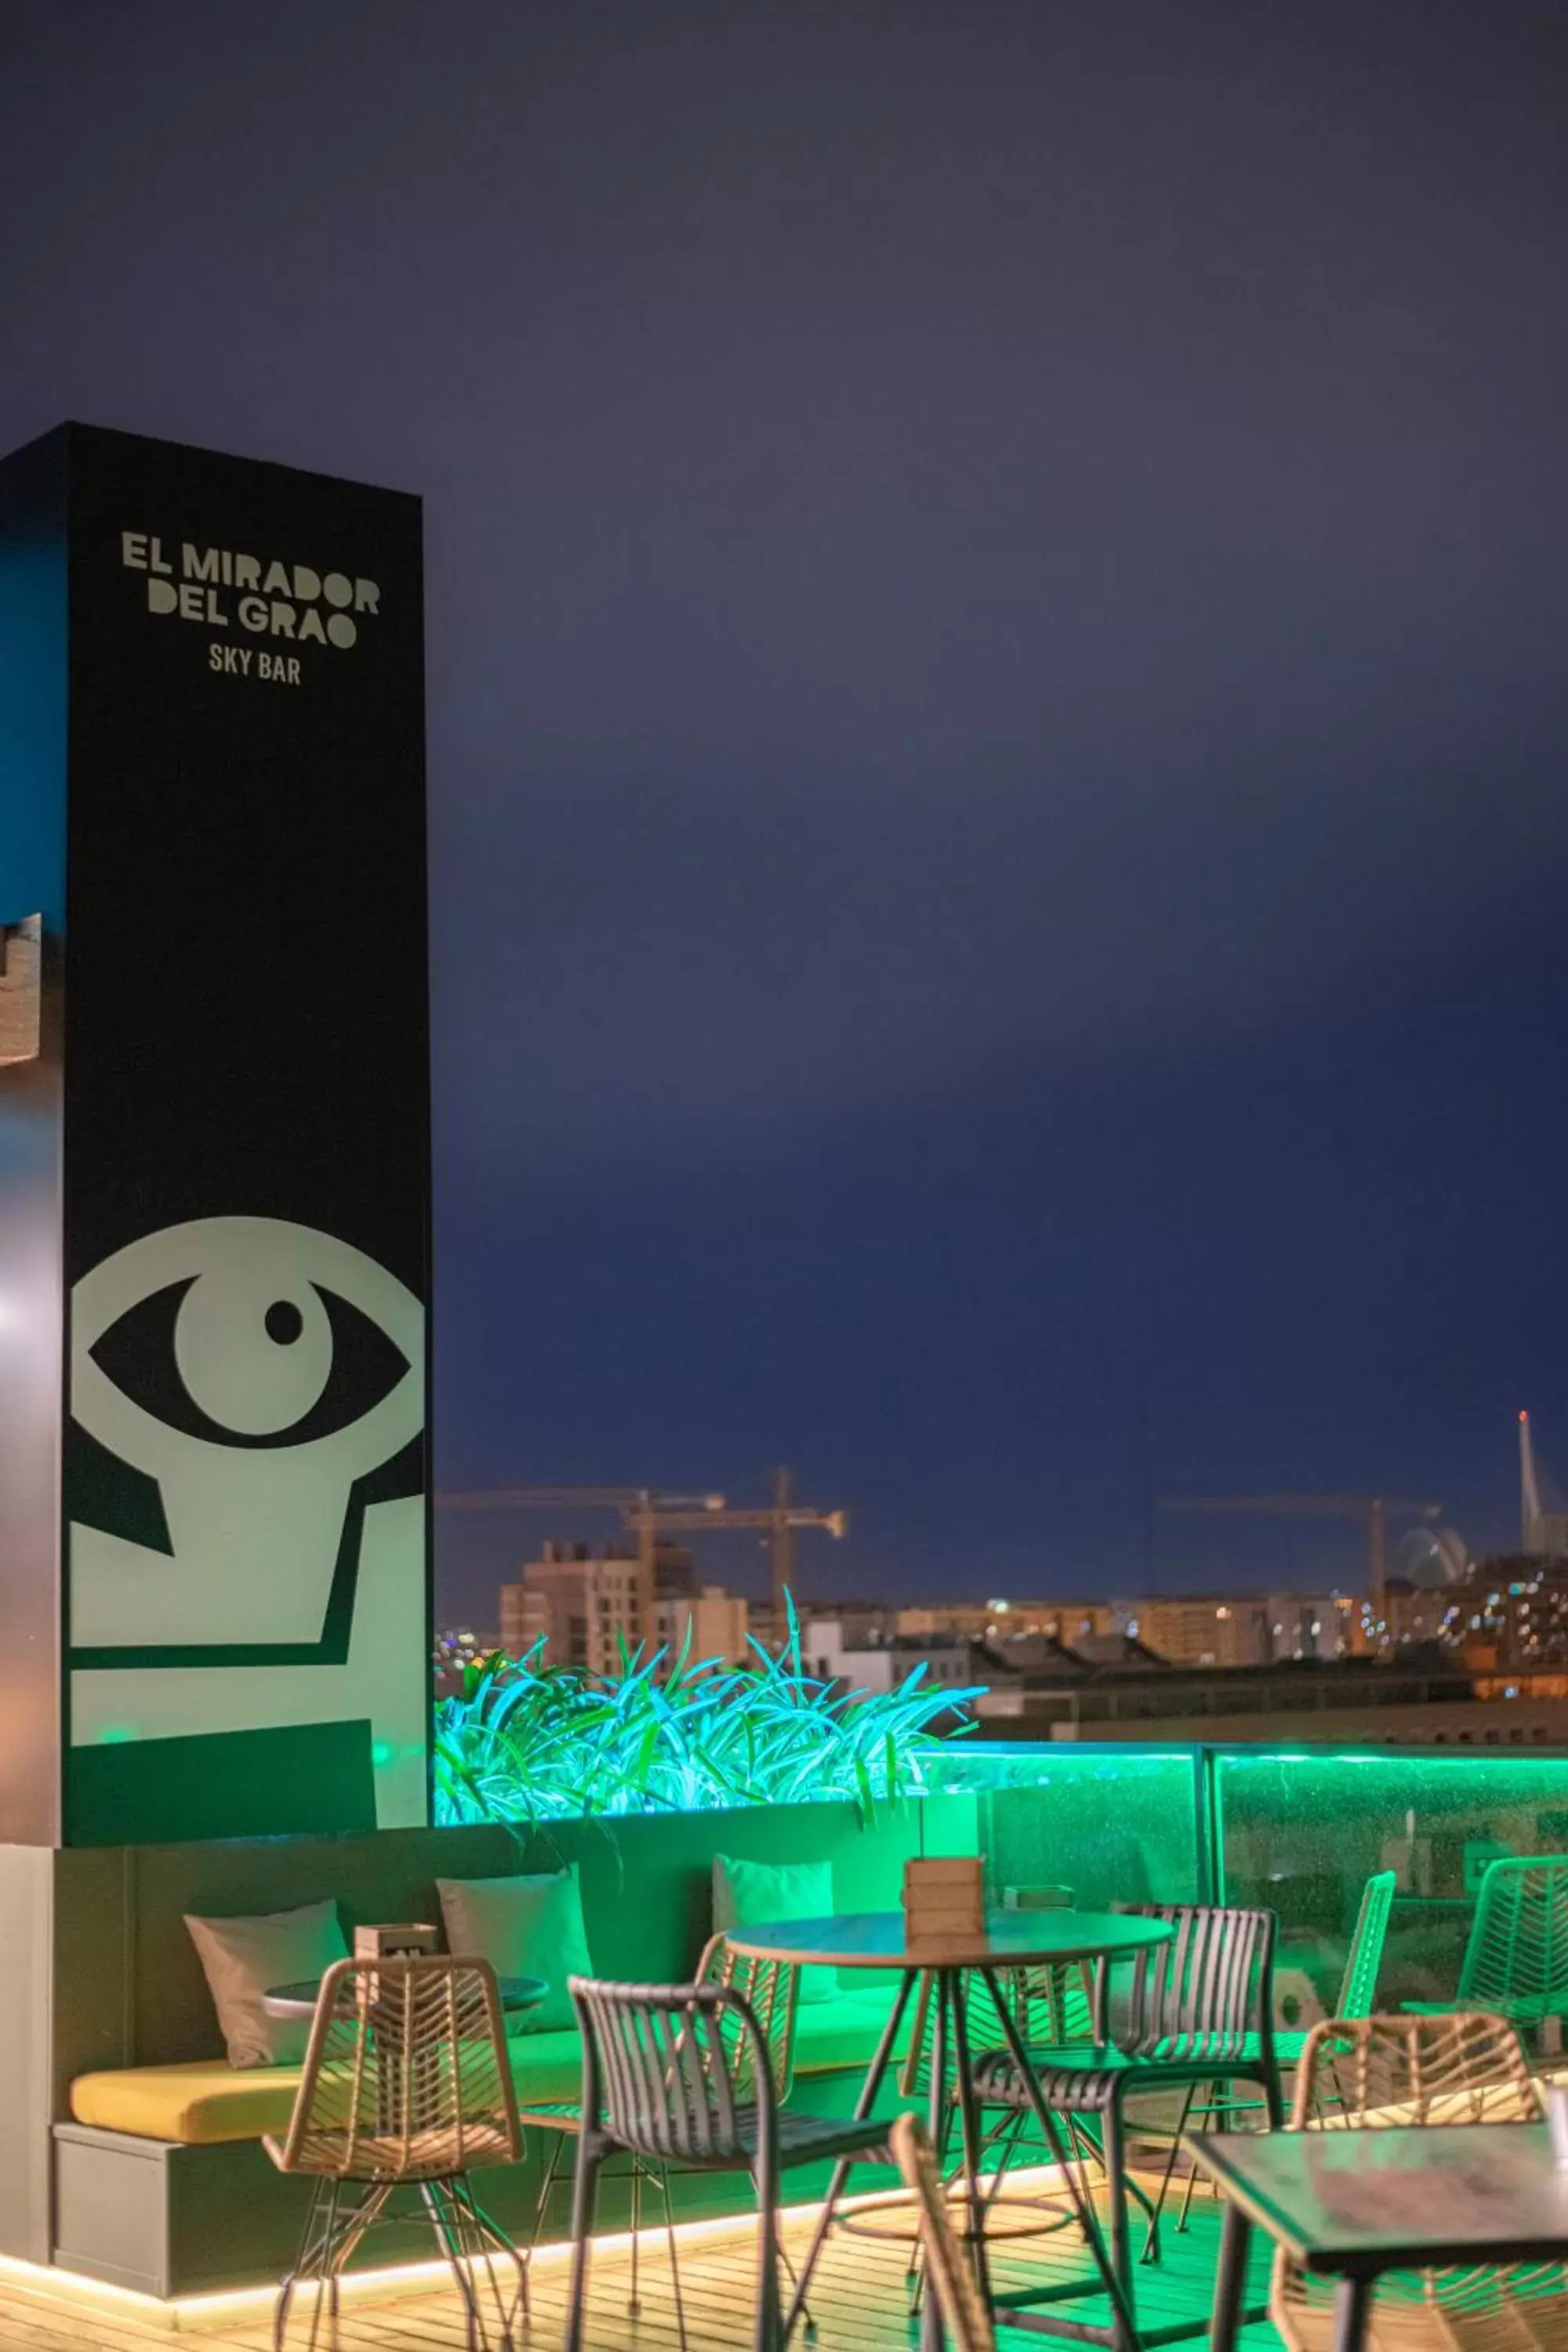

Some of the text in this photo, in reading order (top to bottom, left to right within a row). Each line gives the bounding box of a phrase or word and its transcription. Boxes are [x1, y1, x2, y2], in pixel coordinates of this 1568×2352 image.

[122, 531, 380, 615] EL MIRADOR
[148, 578, 357, 649] DEL GRAO
[209, 643, 300, 685] SKY BAR
